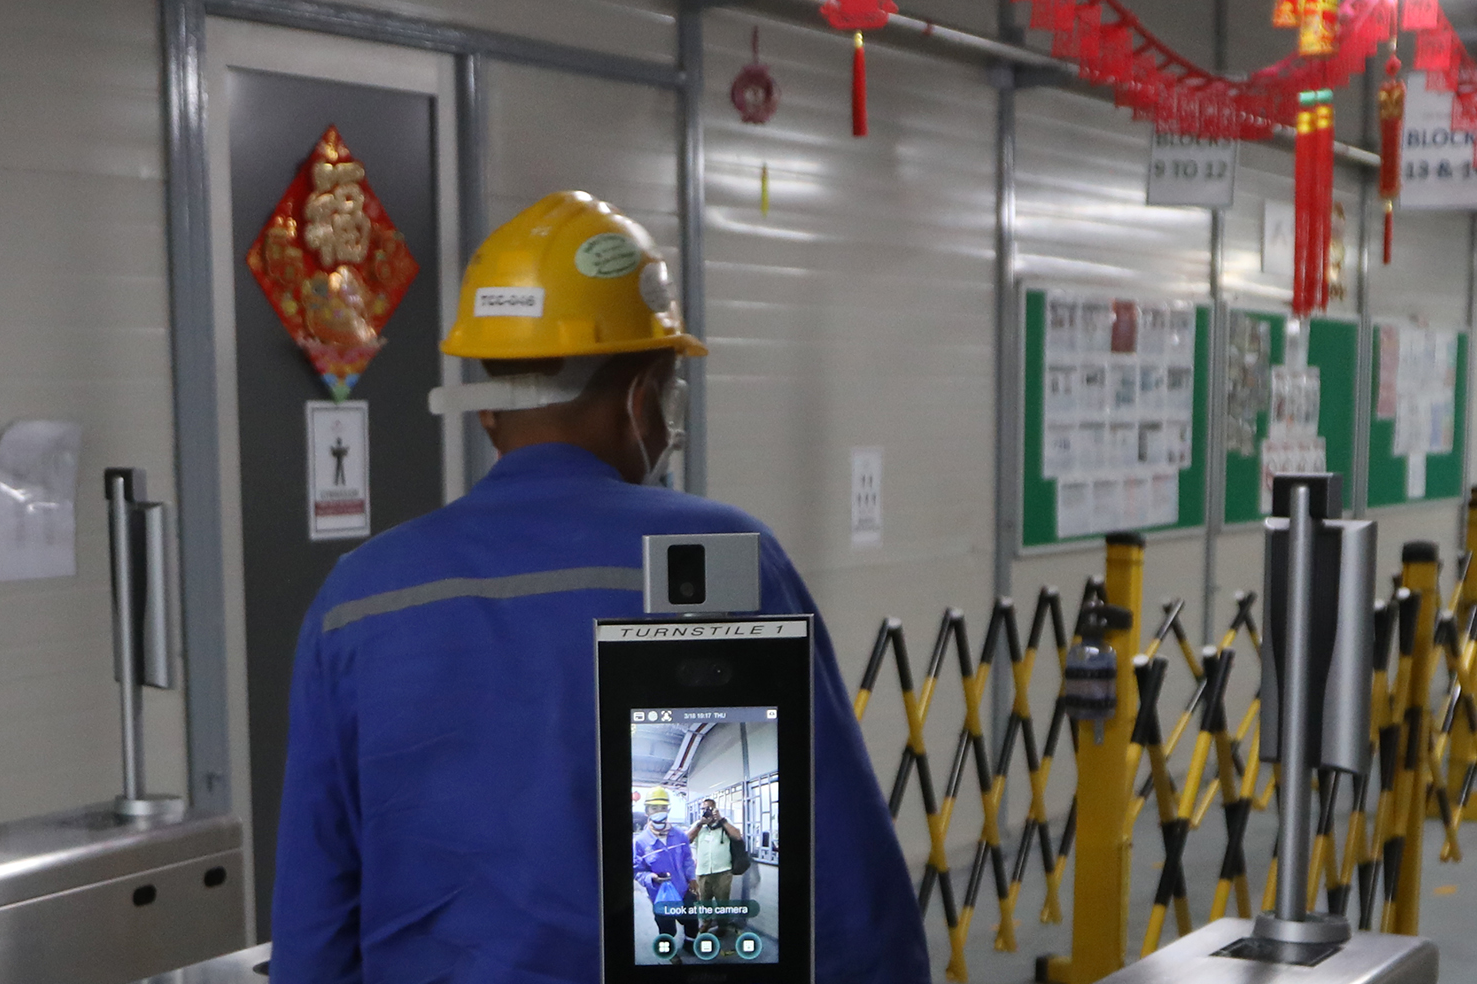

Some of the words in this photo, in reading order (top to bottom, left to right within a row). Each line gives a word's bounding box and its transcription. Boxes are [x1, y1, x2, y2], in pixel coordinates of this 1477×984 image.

[1408, 128, 1474, 147] BLOCK
[1172, 160, 1199, 178] TO
[1206, 160, 1228, 178] 12
[1406, 161, 1429, 179] 13
[1437, 160, 1453, 178] &
[622, 625, 765, 638] TURNSTILE
[775, 625, 784, 635] 1
[664, 905, 687, 915] Look
[688, 905, 698, 915] at
[698, 905, 713, 915] the
[714, 906, 749, 915] camera
